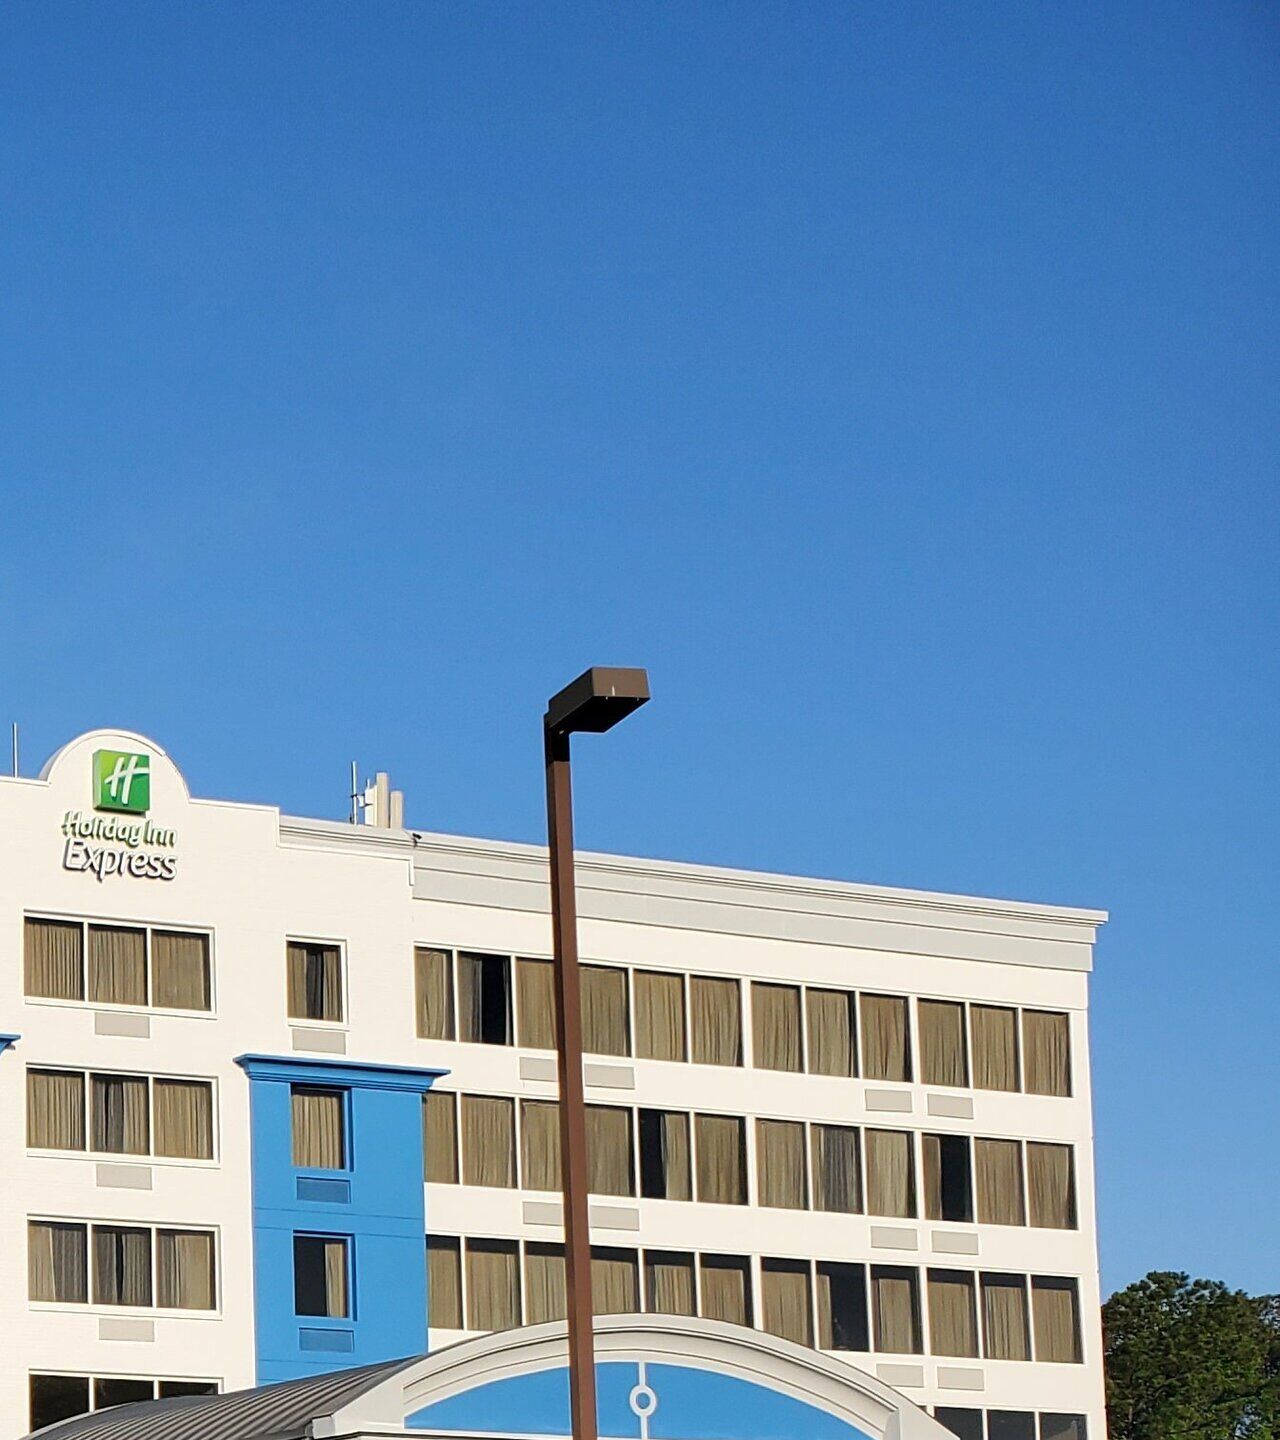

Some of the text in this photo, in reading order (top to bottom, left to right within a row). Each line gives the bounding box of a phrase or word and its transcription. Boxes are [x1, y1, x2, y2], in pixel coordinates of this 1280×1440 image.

[61, 811, 177, 847] Holiday Inn
[62, 837, 177, 883] Express
